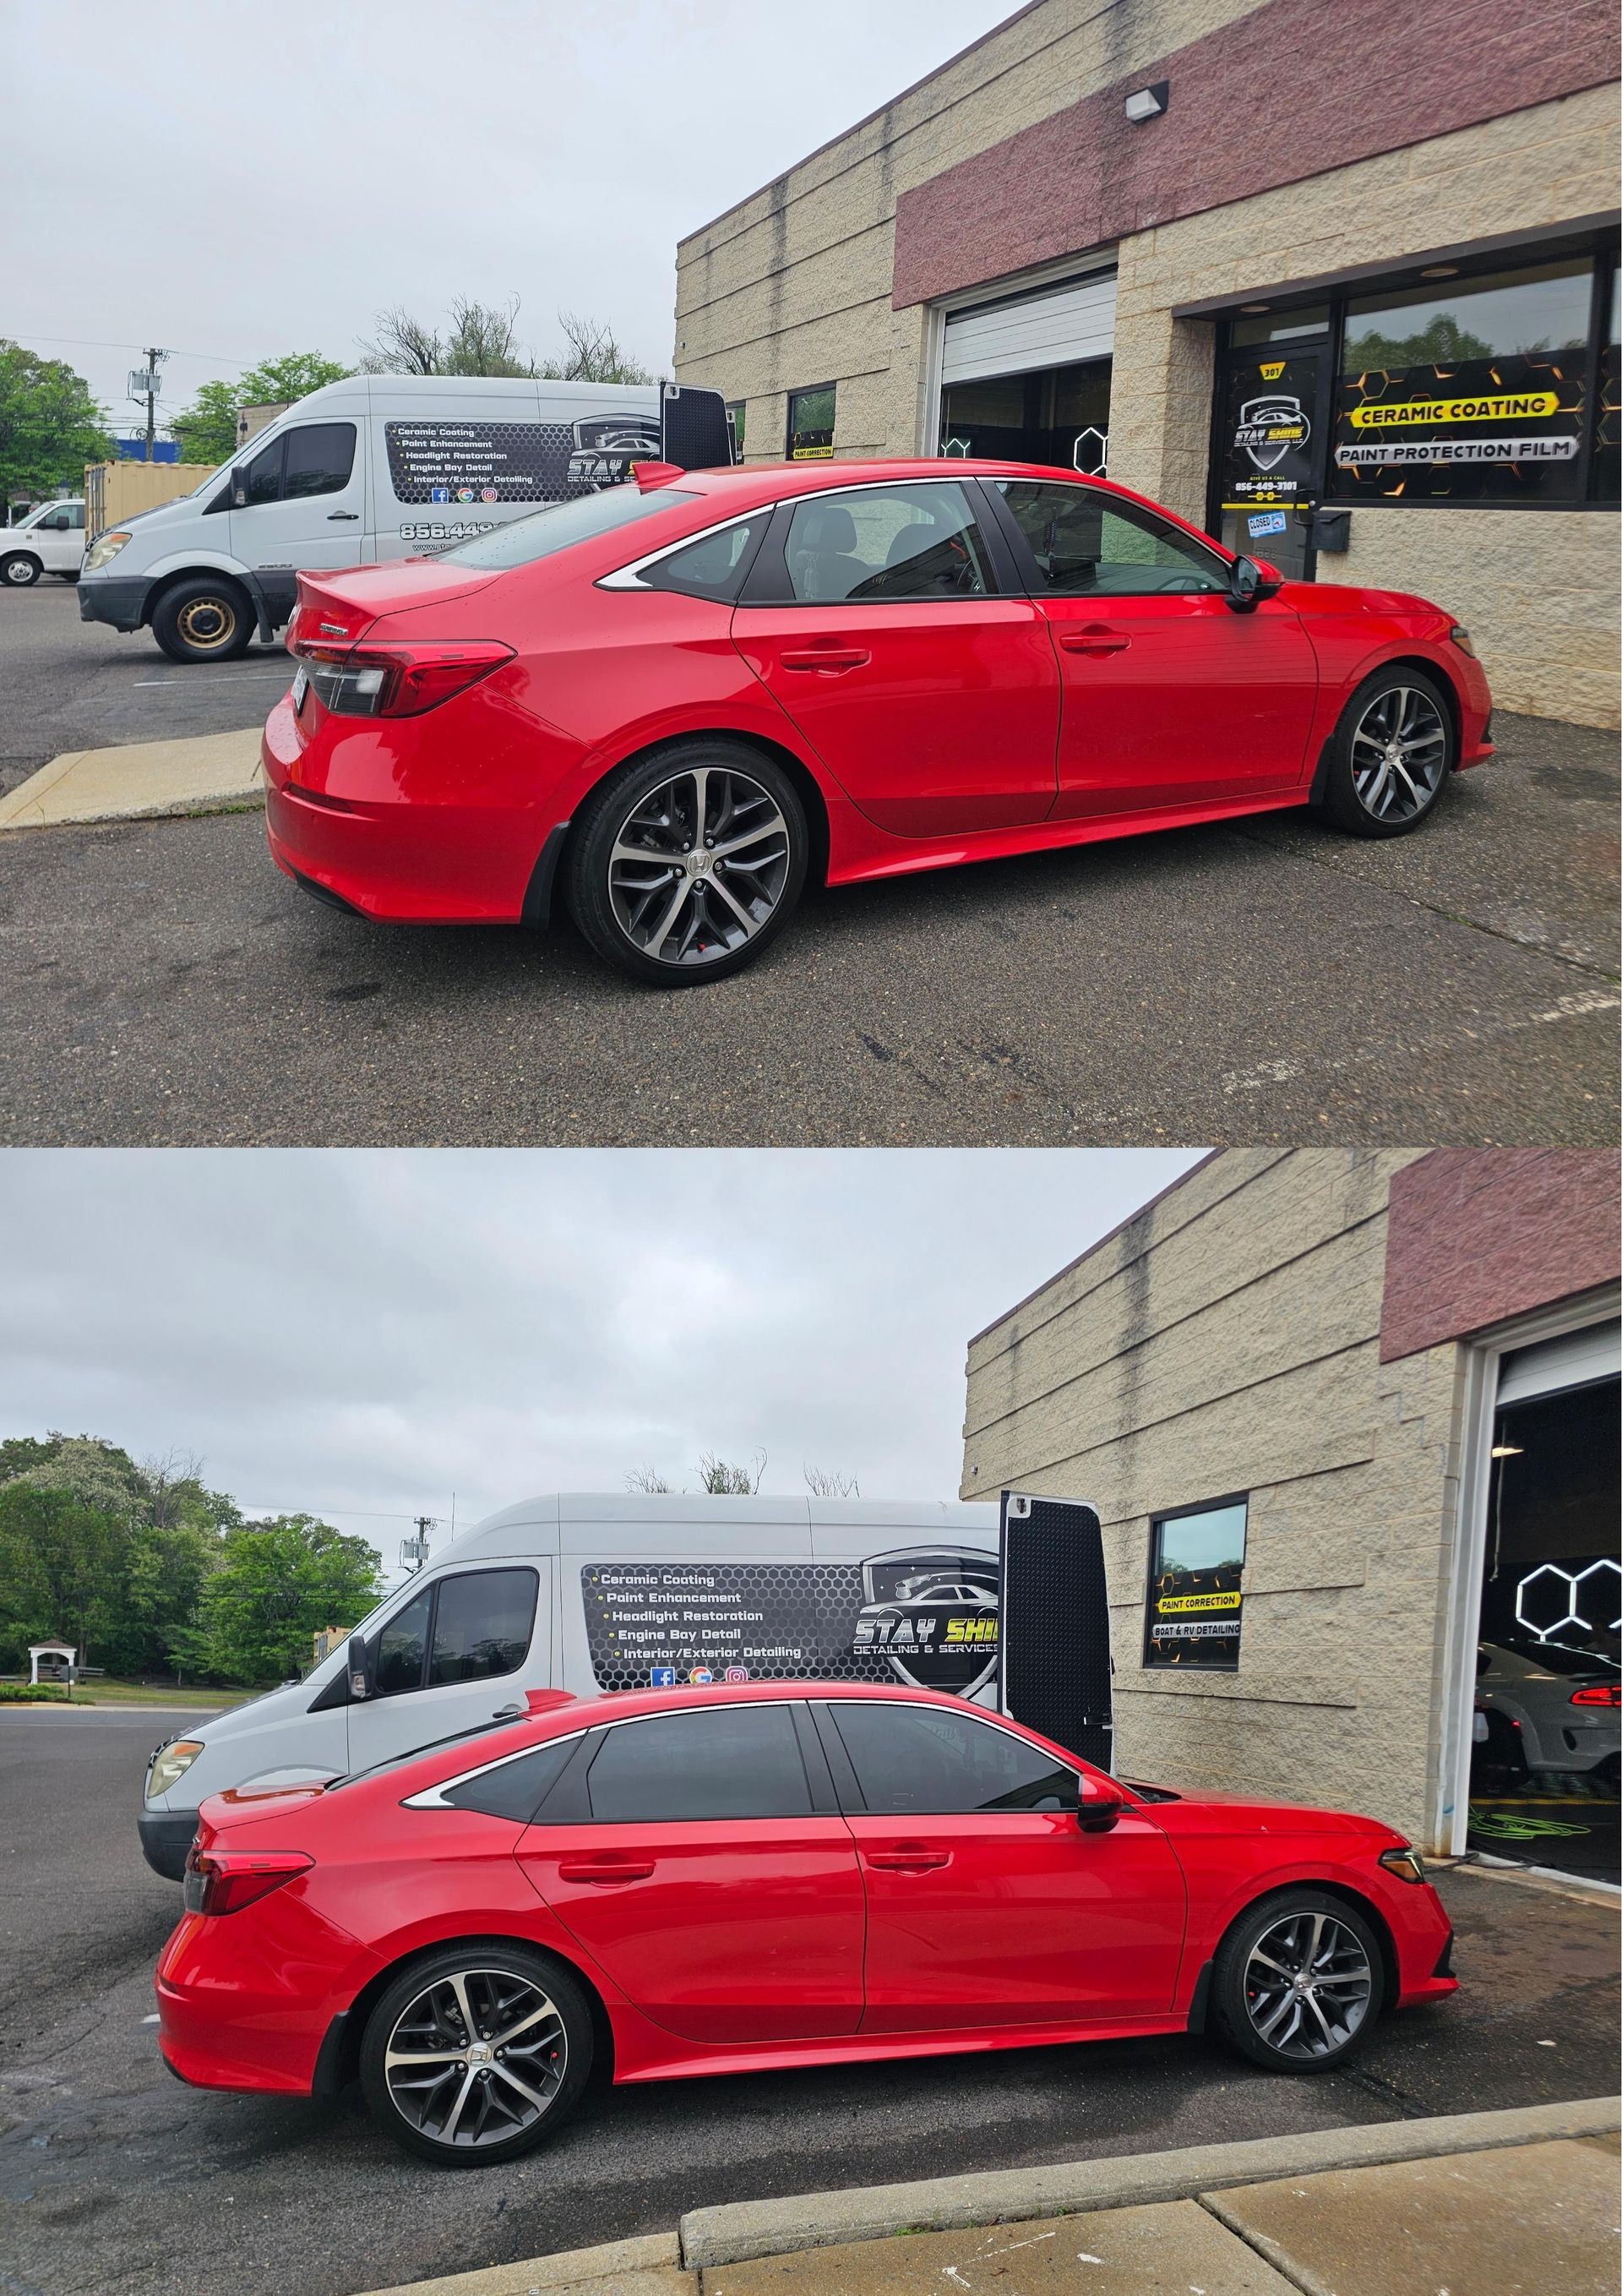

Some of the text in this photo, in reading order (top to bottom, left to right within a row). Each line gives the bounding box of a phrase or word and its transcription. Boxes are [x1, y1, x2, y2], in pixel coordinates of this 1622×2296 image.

[1265, 368, 1280, 377] 301
[1361, 397, 1546, 423] CERAMIC COATING
[439, 428, 475, 438] Coating
[1234, 429, 1266, 442] STAY
[406, 452, 450, 461] Headlight
[1340, 441, 1570, 461] PAINT PROTECTION FILM
[410, 464, 441, 472] Engine
[444, 464, 463, 472] Bay
[567, 459, 623, 475] STAY
[493, 475, 533, 484] Detailing
[1235, 482, 1298, 491] 856-449-3101
[1249, 516, 1271, 530] CLOSED
[601, 1573, 715, 1587] Ceramic Coating
[607, 1592, 742, 1603] Paint Enhancement
[1162, 1595, 1235, 1610] PAINT CORRECTION
[612, 1611, 763, 1623] Headlight Restoration
[618, 1628, 741, 1642] Engine Bay Detail
[852, 1618, 936, 1643] STAY
[1155, 1624, 1240, 1636] BOAT & RV DETAILING
[623, 1646, 802, 1659] Interior/Exterior Detailing
[853, 1645, 918, 1655] DETAILING
[924, 1644, 933, 1654] &
